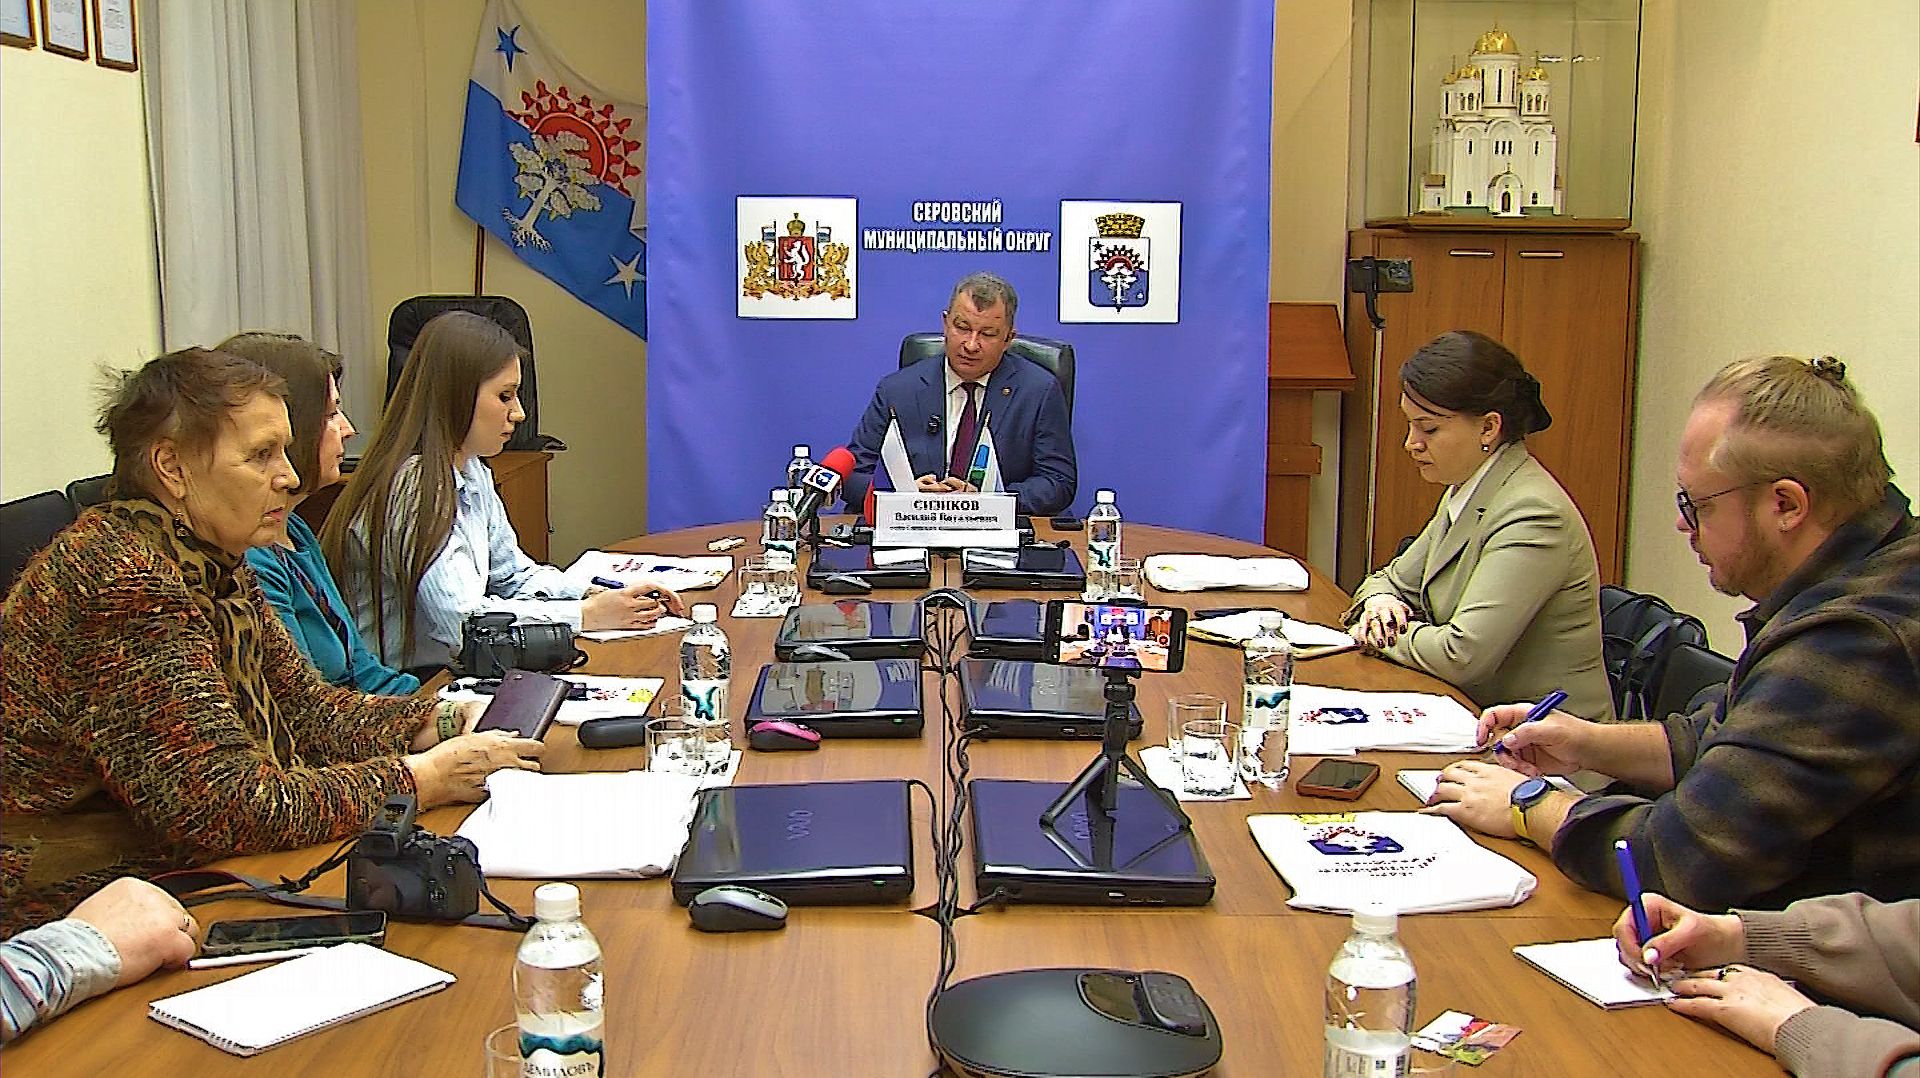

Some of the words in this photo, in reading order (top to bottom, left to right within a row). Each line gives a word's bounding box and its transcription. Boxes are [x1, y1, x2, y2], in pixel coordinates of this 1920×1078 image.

[913, 199, 1002, 223] СЕРОВСКИЙ
[863, 227, 1003, 252] МУНИЦИПАЛЬНЫЙ
[1005, 230, 1051, 251] ОКРУГ
